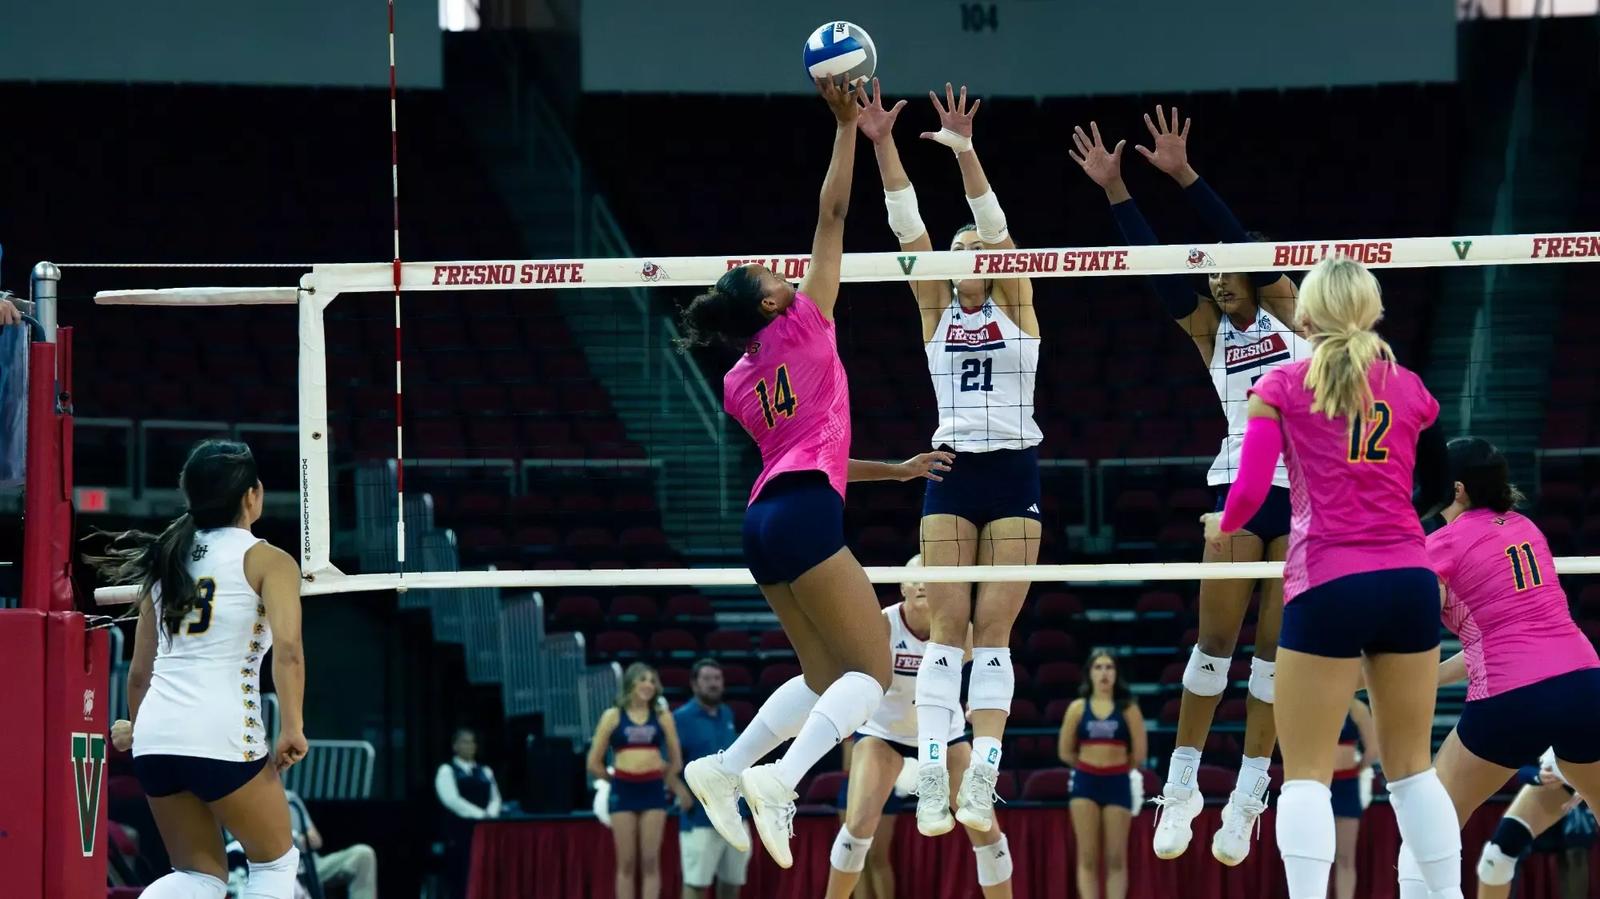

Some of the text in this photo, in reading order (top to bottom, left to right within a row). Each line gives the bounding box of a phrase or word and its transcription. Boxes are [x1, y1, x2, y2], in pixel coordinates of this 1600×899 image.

[960, 3, 998, 32] 104
[432, 263, 585, 286] FRESNO STATE
[973, 250, 1129, 274] FRESNO STATE
[960, 357, 993, 392] 21
[754, 363, 797, 429] 14
[1505, 541, 1542, 592] 11
